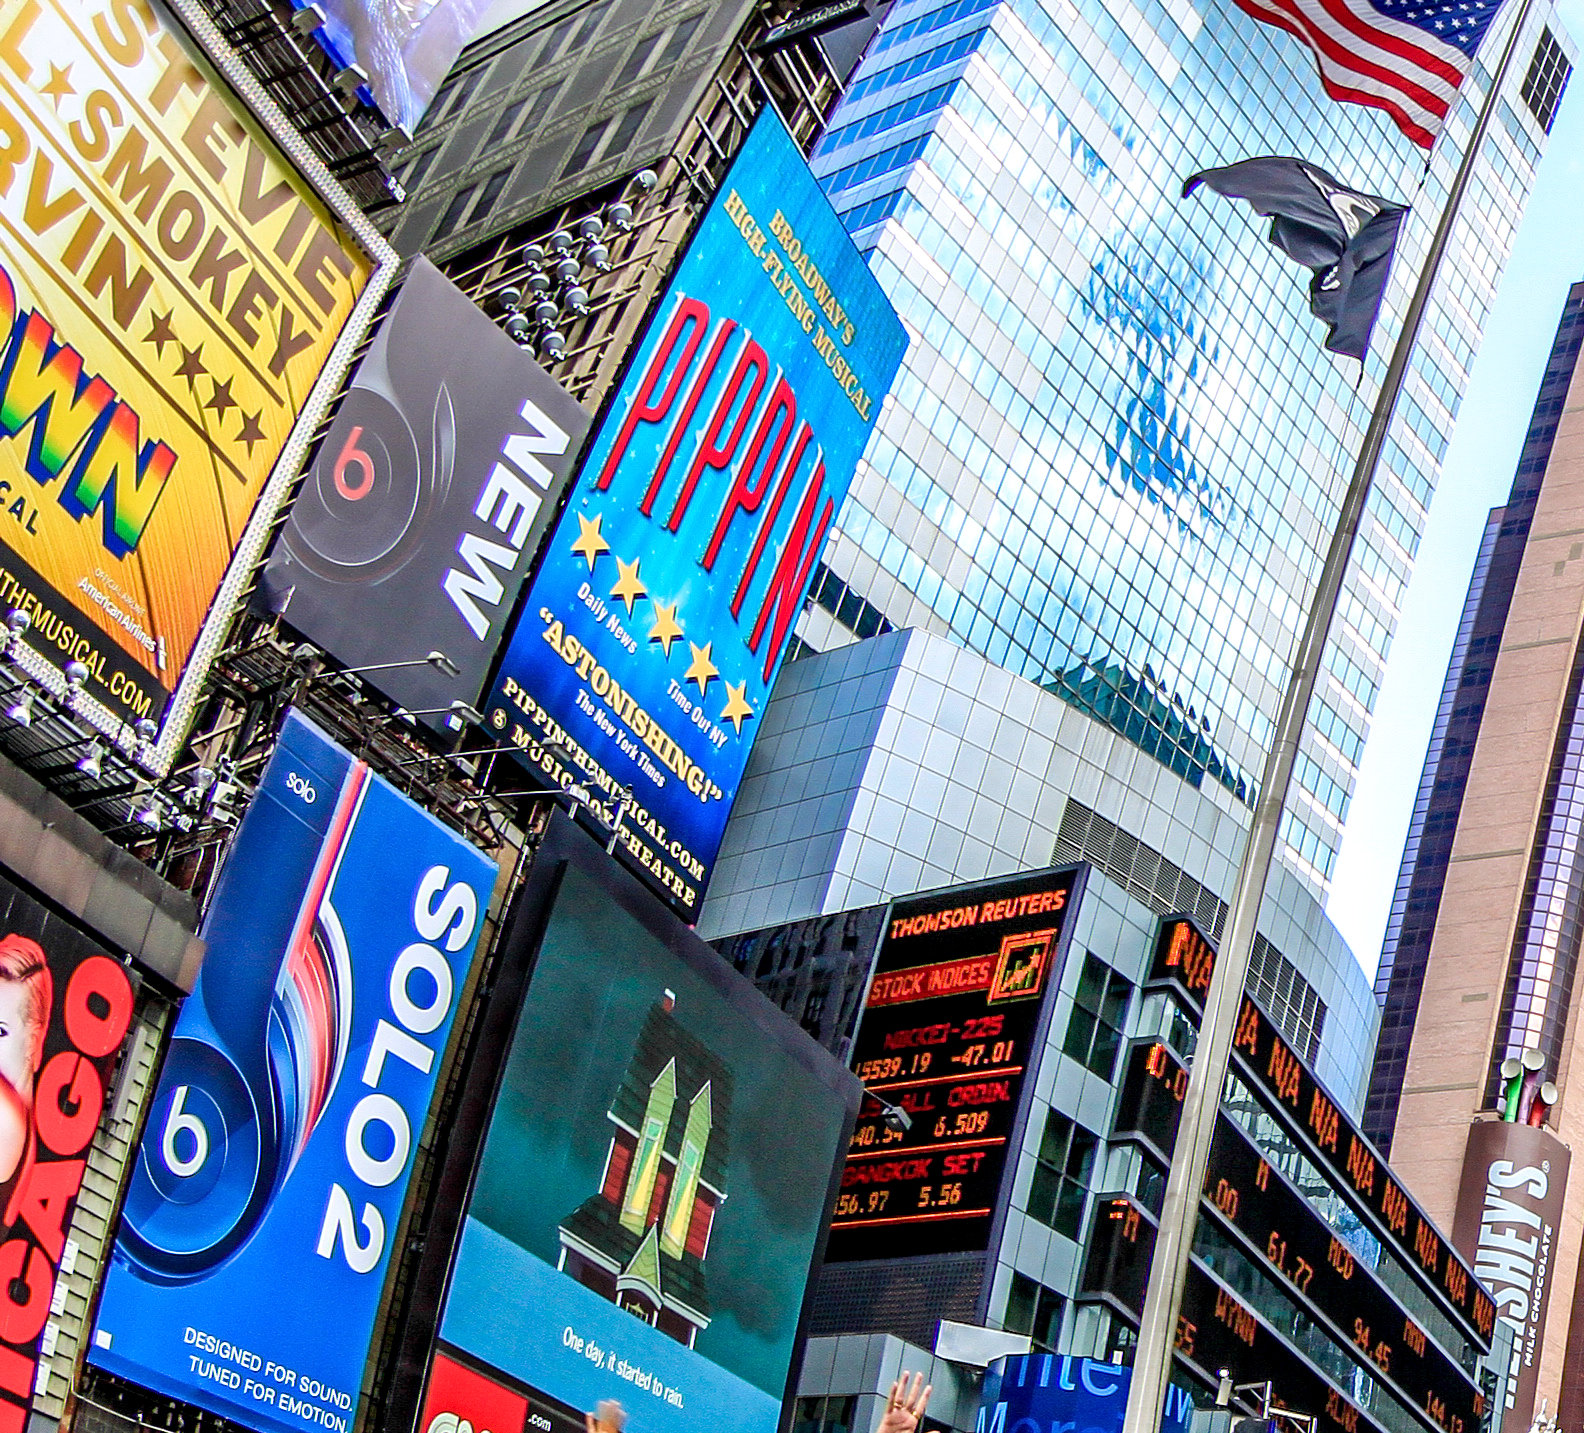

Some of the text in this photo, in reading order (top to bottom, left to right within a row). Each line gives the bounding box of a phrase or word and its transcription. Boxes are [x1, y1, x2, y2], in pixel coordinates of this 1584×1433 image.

[92, 0, 358, 319] STEVIE
[68, 88, 315, 381] SMOKEY
[723, 188, 872, 422] HIGH-FLYING MUSICAL
[769, 208, 855, 347] BROADWAY'S
[444, 400, 571, 643] NEW
[594, 293, 834, 685] PIPPIN
[78, 577, 157, 653] American Airlines
[577, 582, 637, 654] Daily News
[575, 689, 666, 789] The New York Times
[667, 678, 728, 749] Time Out NY
[285, 770, 316, 803] solo
[511, 724, 696, 907] MUSIC THEATRE
[890, 889, 1068, 939] THOMSON REUTERS
[871, 961, 991, 1001] STOCK INDICES
[951, 1040, 1014, 1067] -47.01
[901, 1089, 933, 1114] ALL
[841, 1152, 986, 1187] BANGKOK SET
[918, 1181, 963, 1207] 5.56
[1267, 1042, 1301, 1106] N/A
[1308, 1088, 1339, 1153] N/A
[1347, 1135, 1375, 1197] N/A
[1381, 1177, 1408, 1236] N/A
[1414, 1217, 1439, 1274] N/A
[1445, 1254, 1467, 1307] N/A
[1523, 1224, 1553, 1369] MILK CHOCOLATE
[183, 1327, 354, 1414] DESIGNED FOR SOUND.
[189, 1355, 240, 1388] TUNED
[242, 1373, 276, 1402] FOR
[563, 1326, 685, 1409] One day, started to rain.
[528, 1413, 551, 1432] .com
